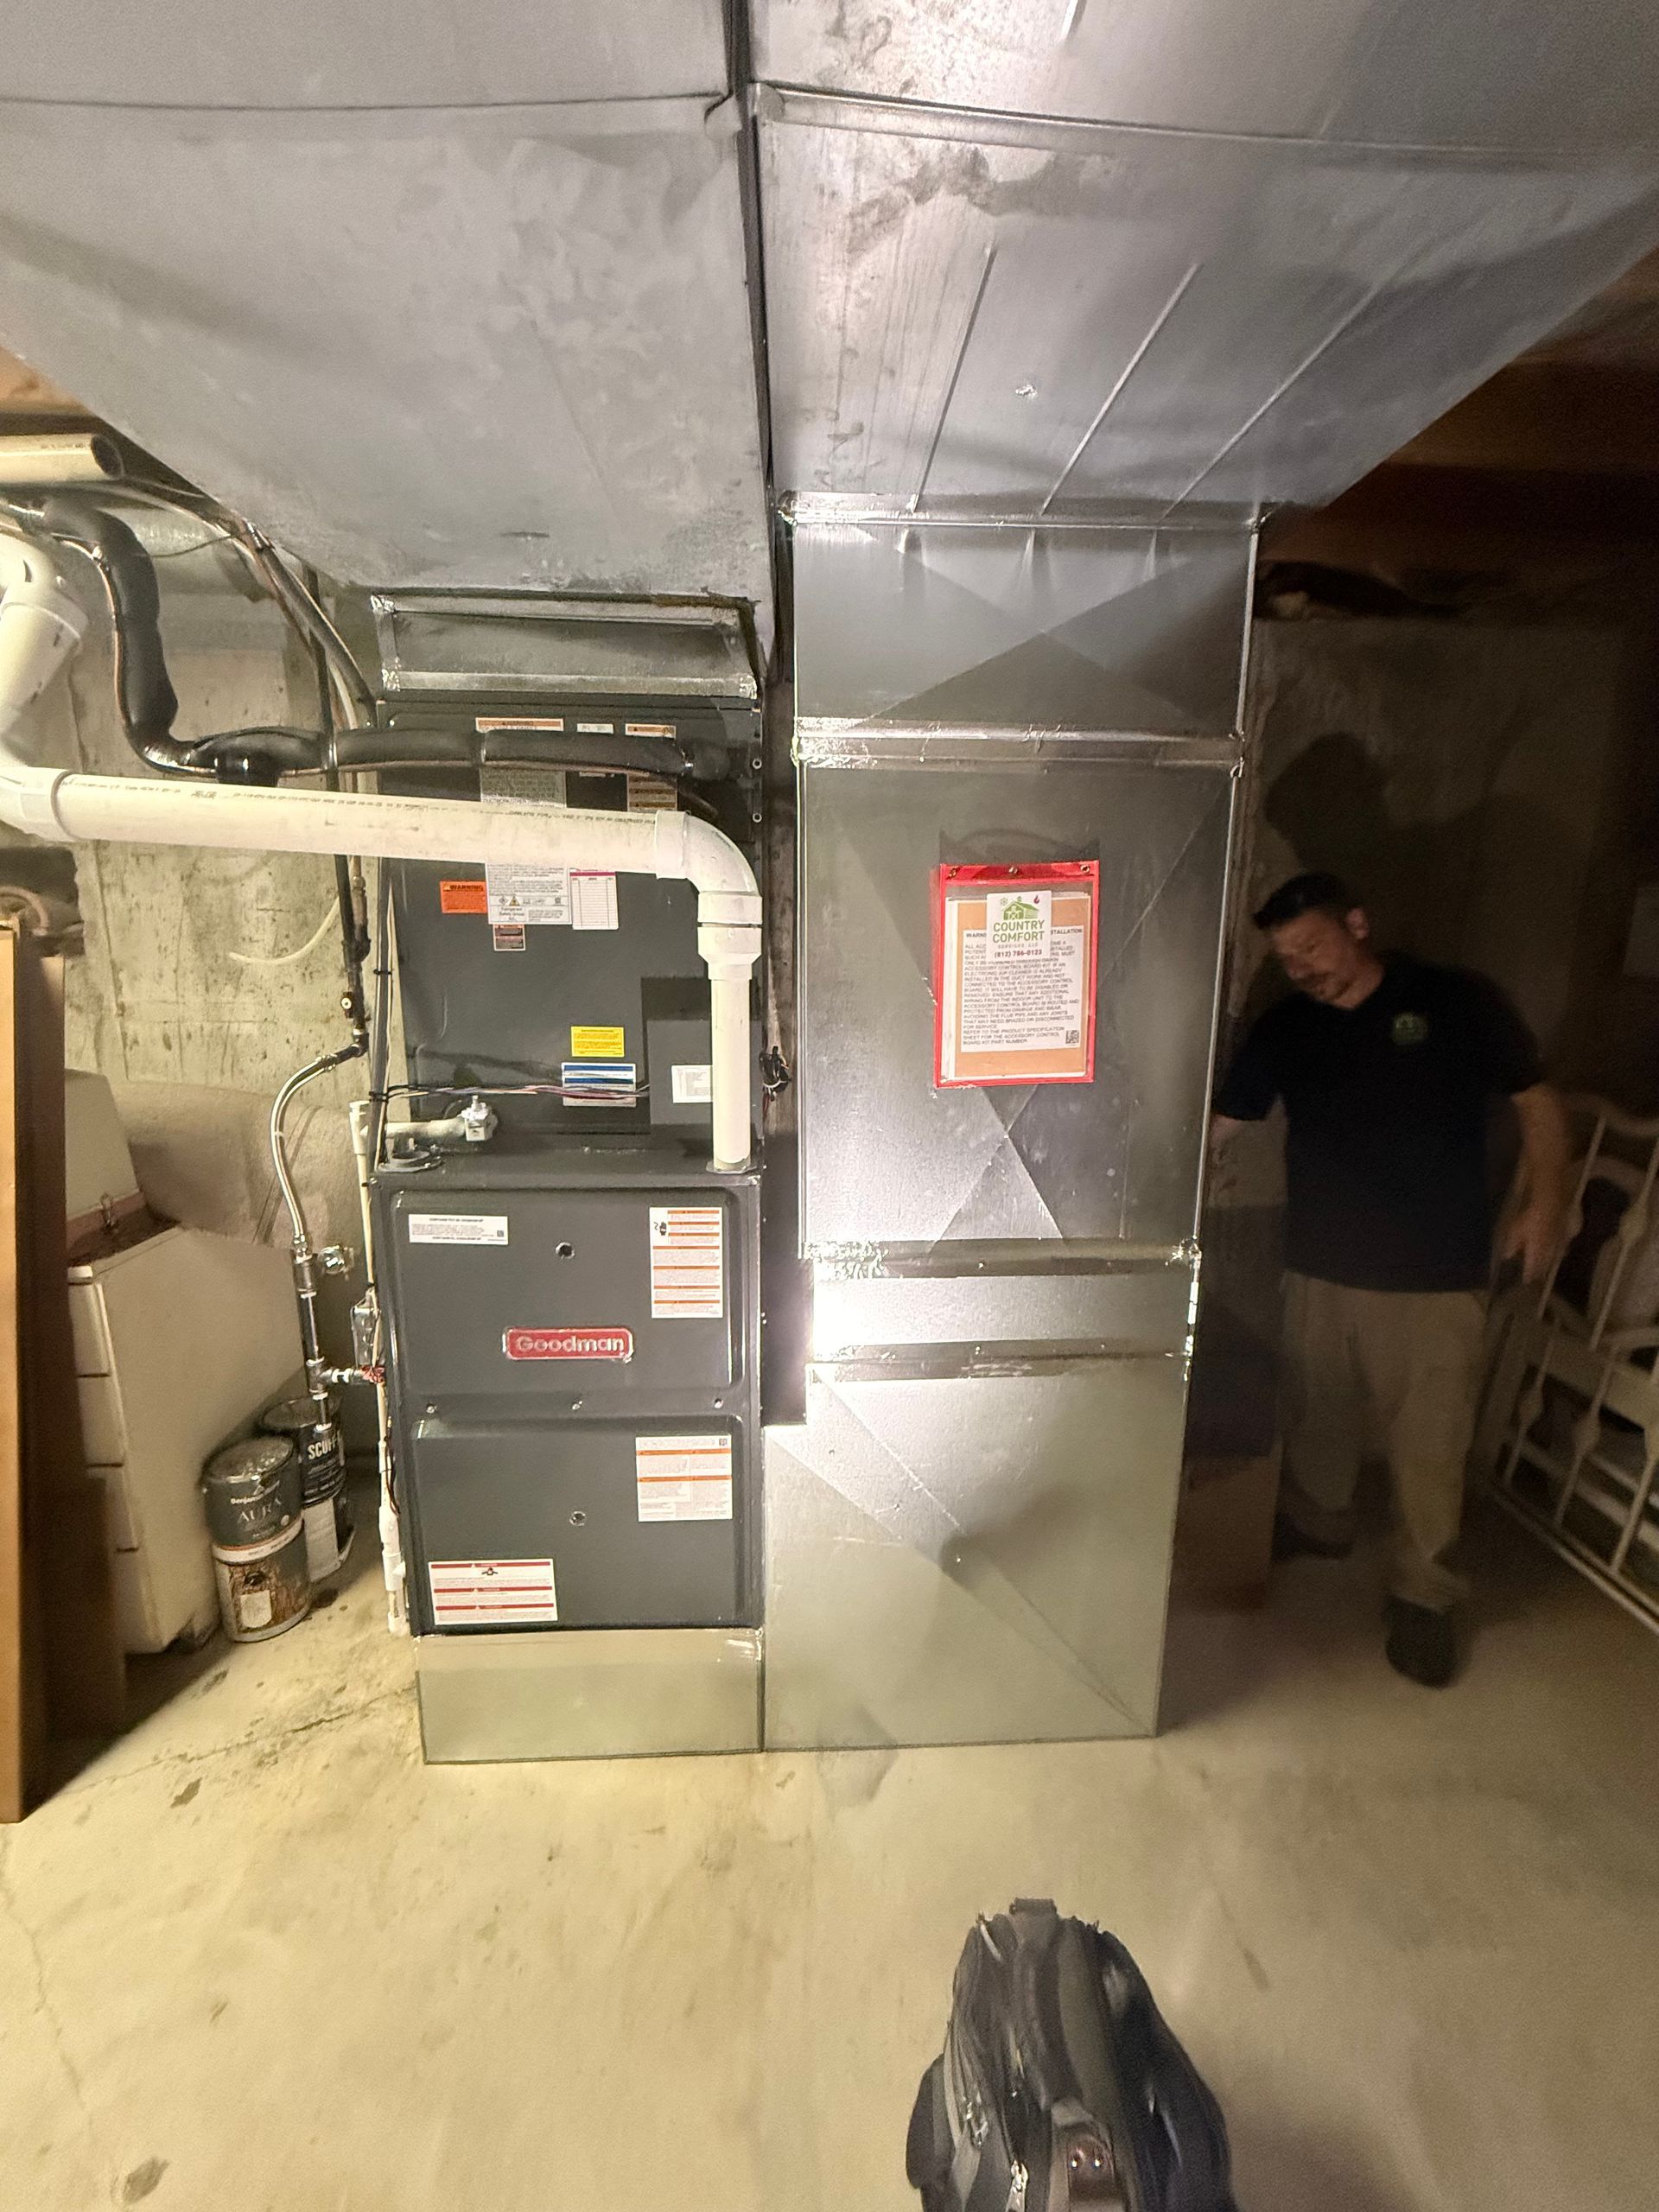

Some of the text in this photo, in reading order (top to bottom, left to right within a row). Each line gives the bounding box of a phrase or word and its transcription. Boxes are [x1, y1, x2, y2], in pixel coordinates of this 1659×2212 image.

[993, 919, 1045, 932] COUNTRY
[992, 931, 1045, 944] COMFORT
[516, 1335, 625, 1352] Goodman
